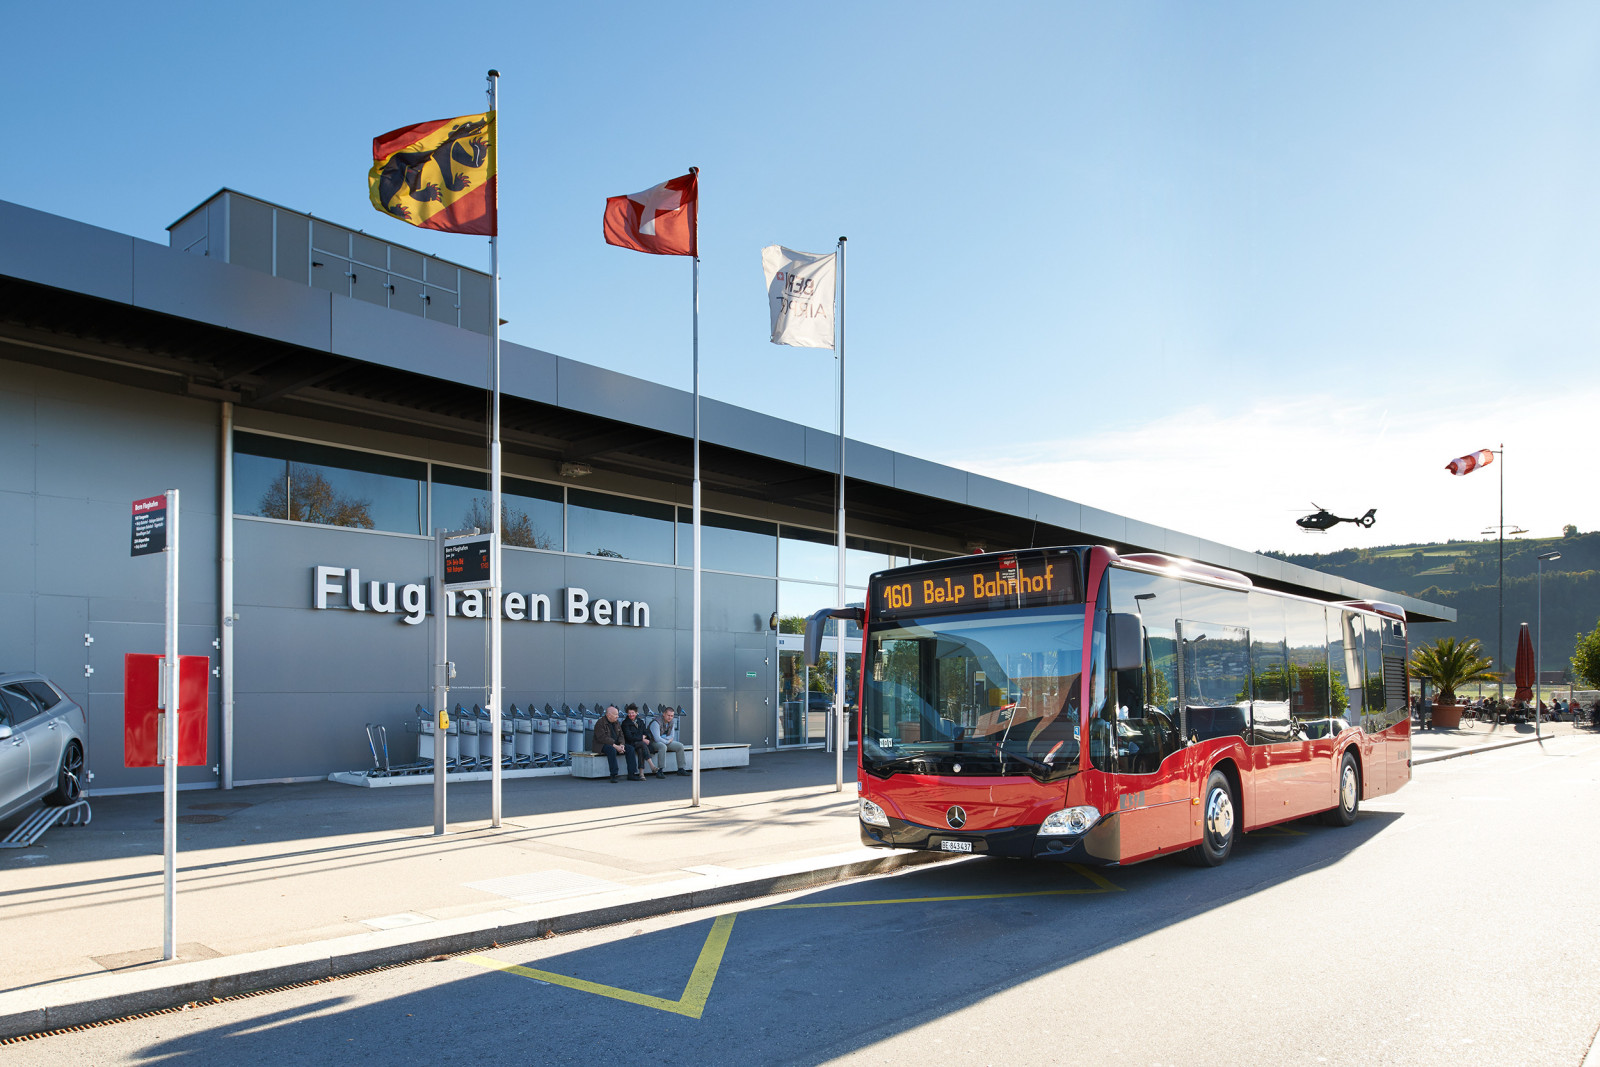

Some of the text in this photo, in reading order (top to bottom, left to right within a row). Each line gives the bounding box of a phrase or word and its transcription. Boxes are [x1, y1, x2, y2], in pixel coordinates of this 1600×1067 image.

[313, 565, 650, 627] Flugaen Bern
[883, 583, 912, 609] 160
[923, 577, 965, 604] Belp
[973, 564, 1054, 599] Bahnhof
